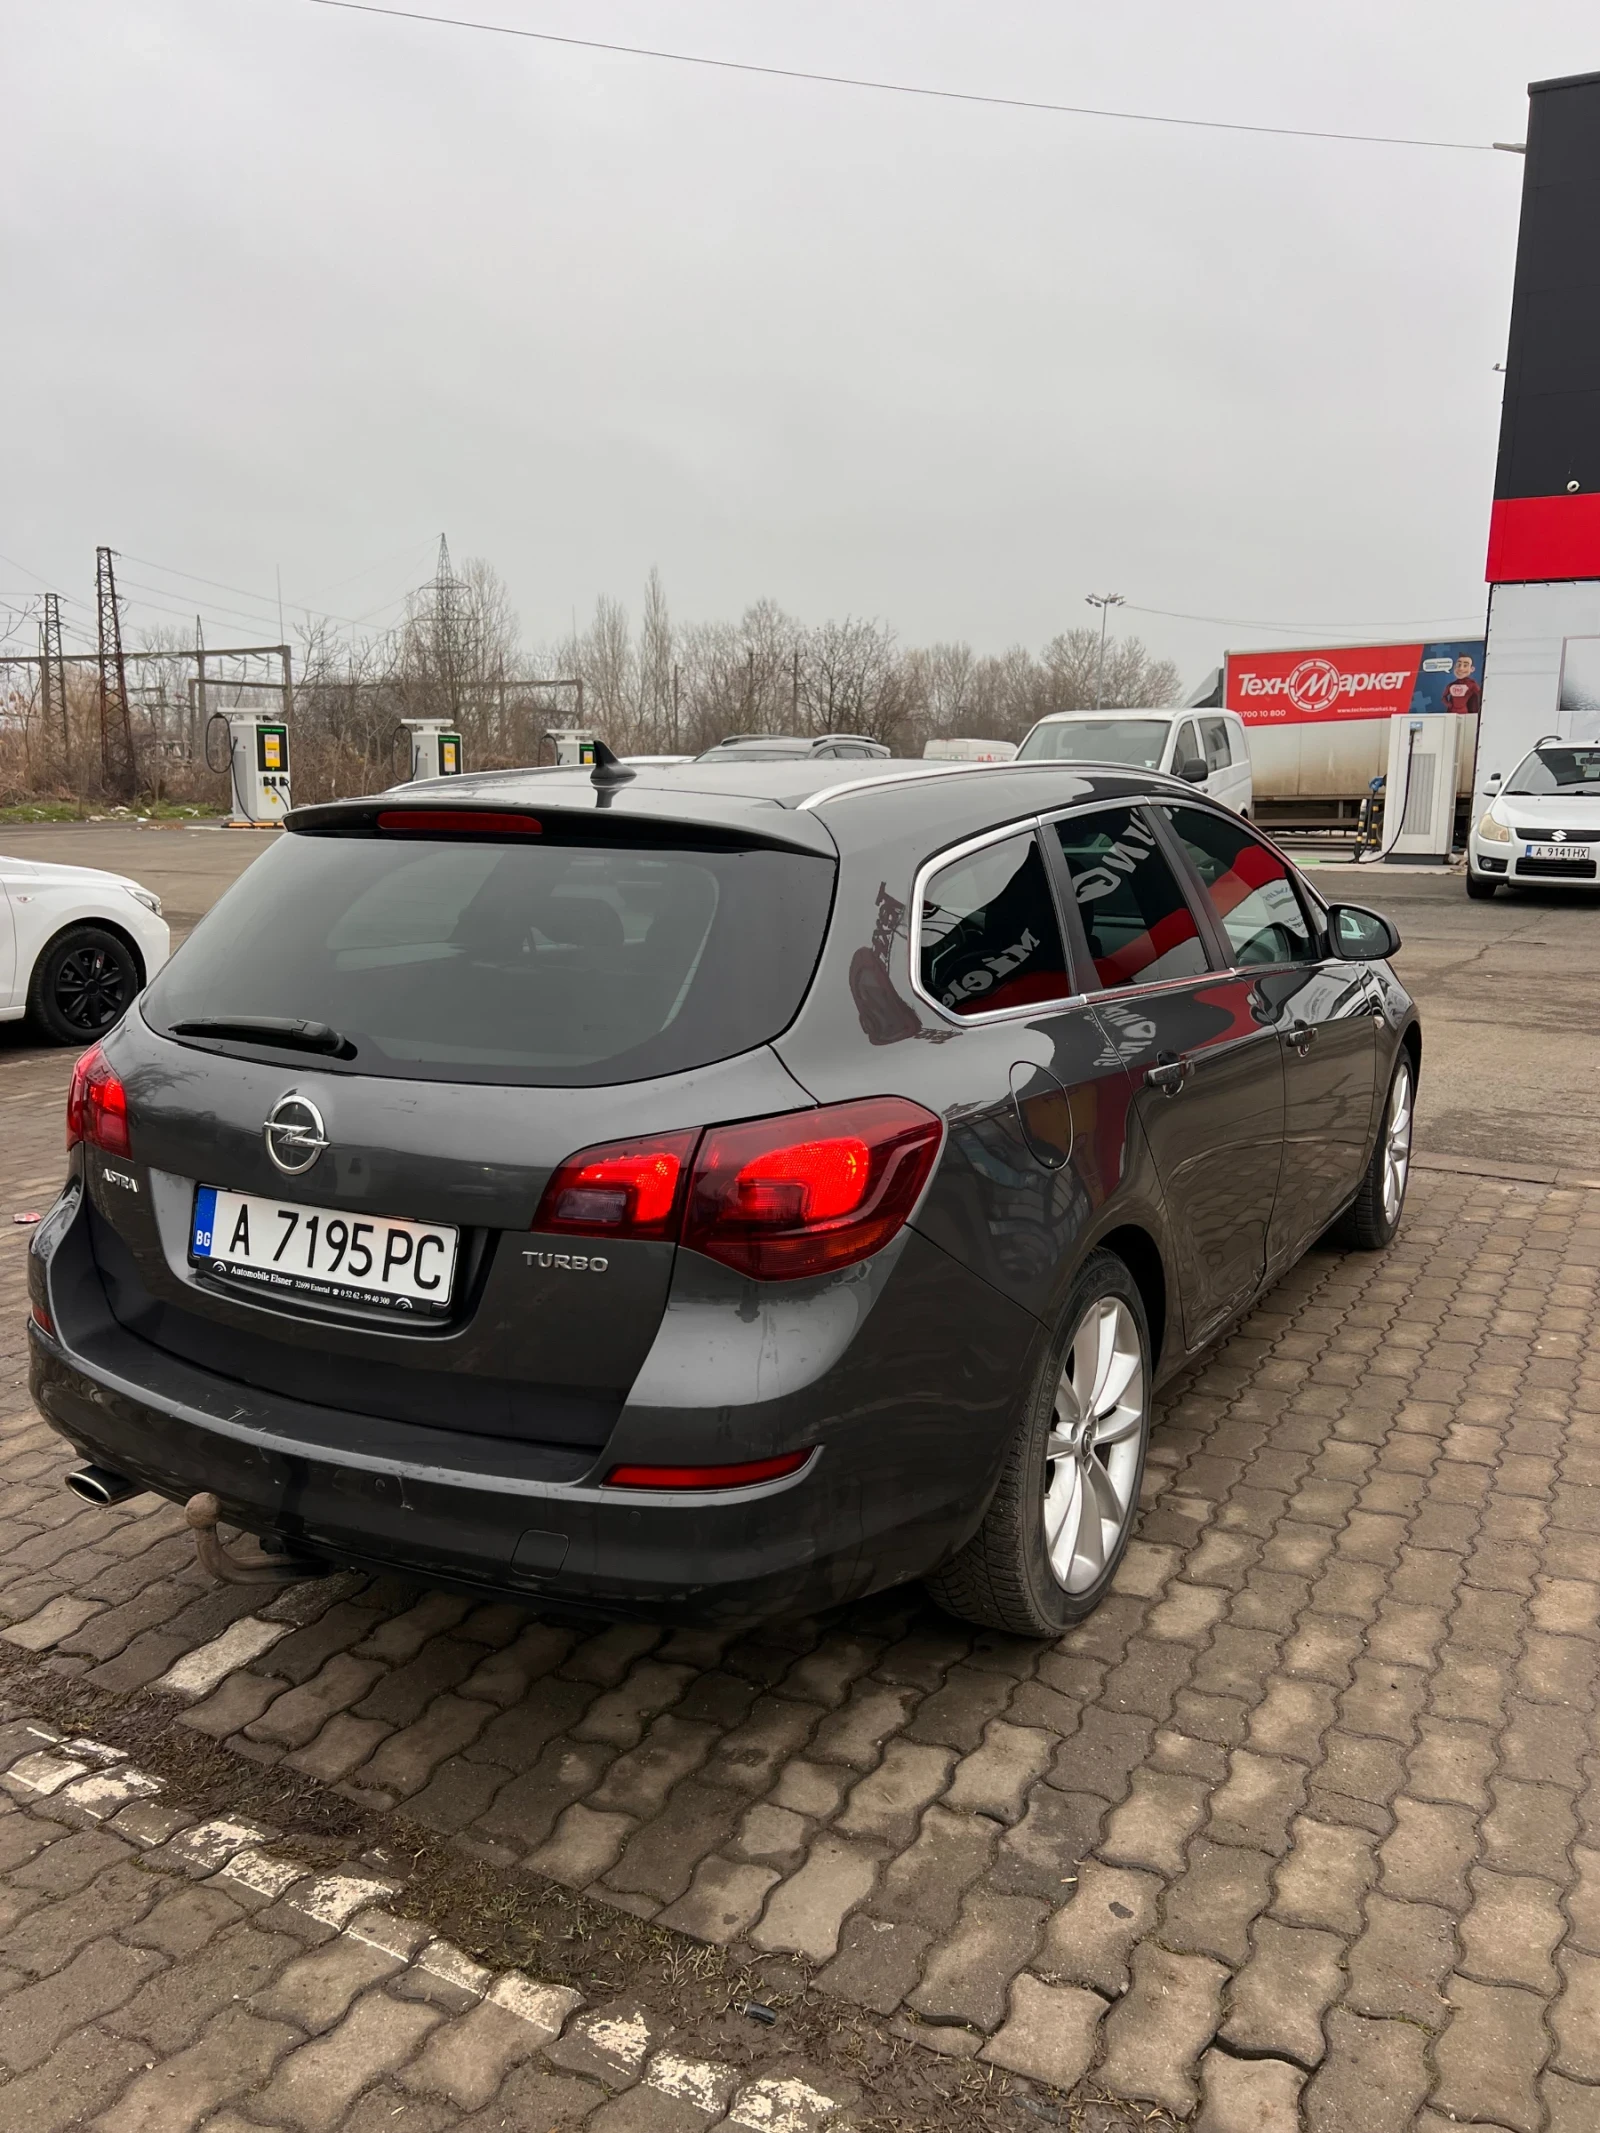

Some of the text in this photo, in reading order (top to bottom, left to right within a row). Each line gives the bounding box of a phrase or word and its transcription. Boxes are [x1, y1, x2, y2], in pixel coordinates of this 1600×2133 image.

[1259, 710, 1268, 718] 10
[1270, 709, 1286, 717] 800
[1536, 847, 1542, 856] A
[1548, 847, 1571, 857] 9141
[1573, 848, 1587, 858] HX
[102, 1168, 139, 1193] ASTRA
[196, 1229, 211, 1247] BG
[229, 1203, 445, 1290] A 7195 PC
[521, 1250, 609, 1272] TURBO
[230, 1265, 270, 1281] Automobile
[270, 1273, 293, 1286] Elsner
